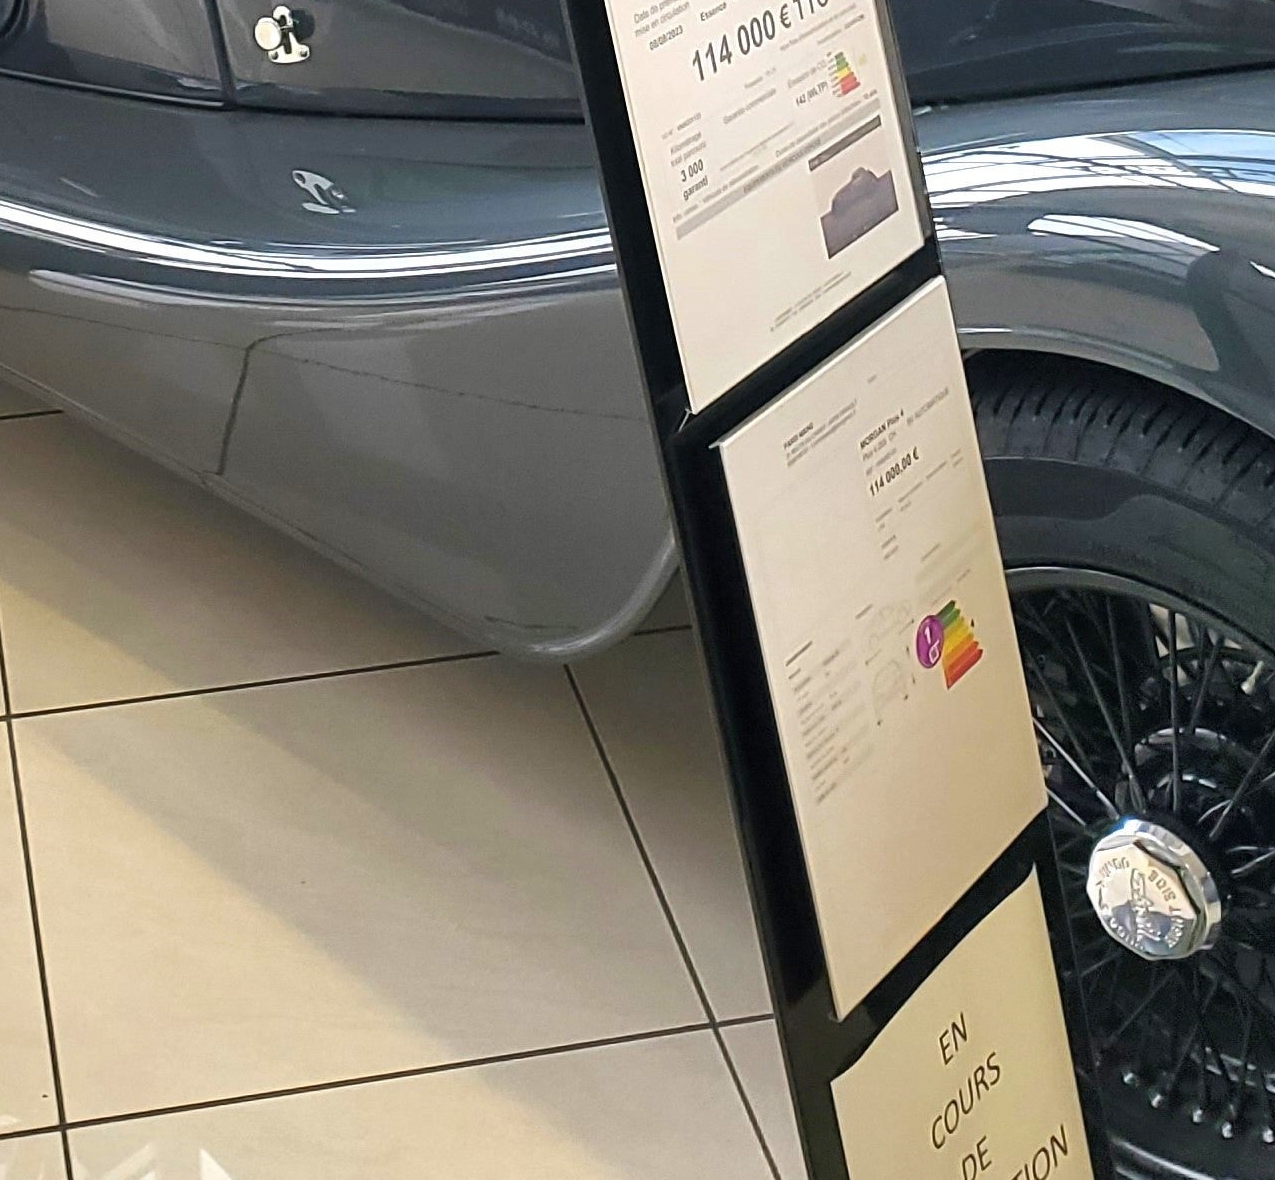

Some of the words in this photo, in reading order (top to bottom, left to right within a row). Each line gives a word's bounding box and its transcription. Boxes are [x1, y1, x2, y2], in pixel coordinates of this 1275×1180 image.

[692, 33, 733, 82] 114
[737, 9, 776, 56] 000
[779, 3, 792, 29] €
[680, 169, 687, 183] 3
[687, 158, 704, 178] 000
[869, 474, 885, 497] 114
[939, 1011, 968, 1066] EN
[931, 1051, 1001, 1150] COURS
[961, 1135, 993, 1180] DE
